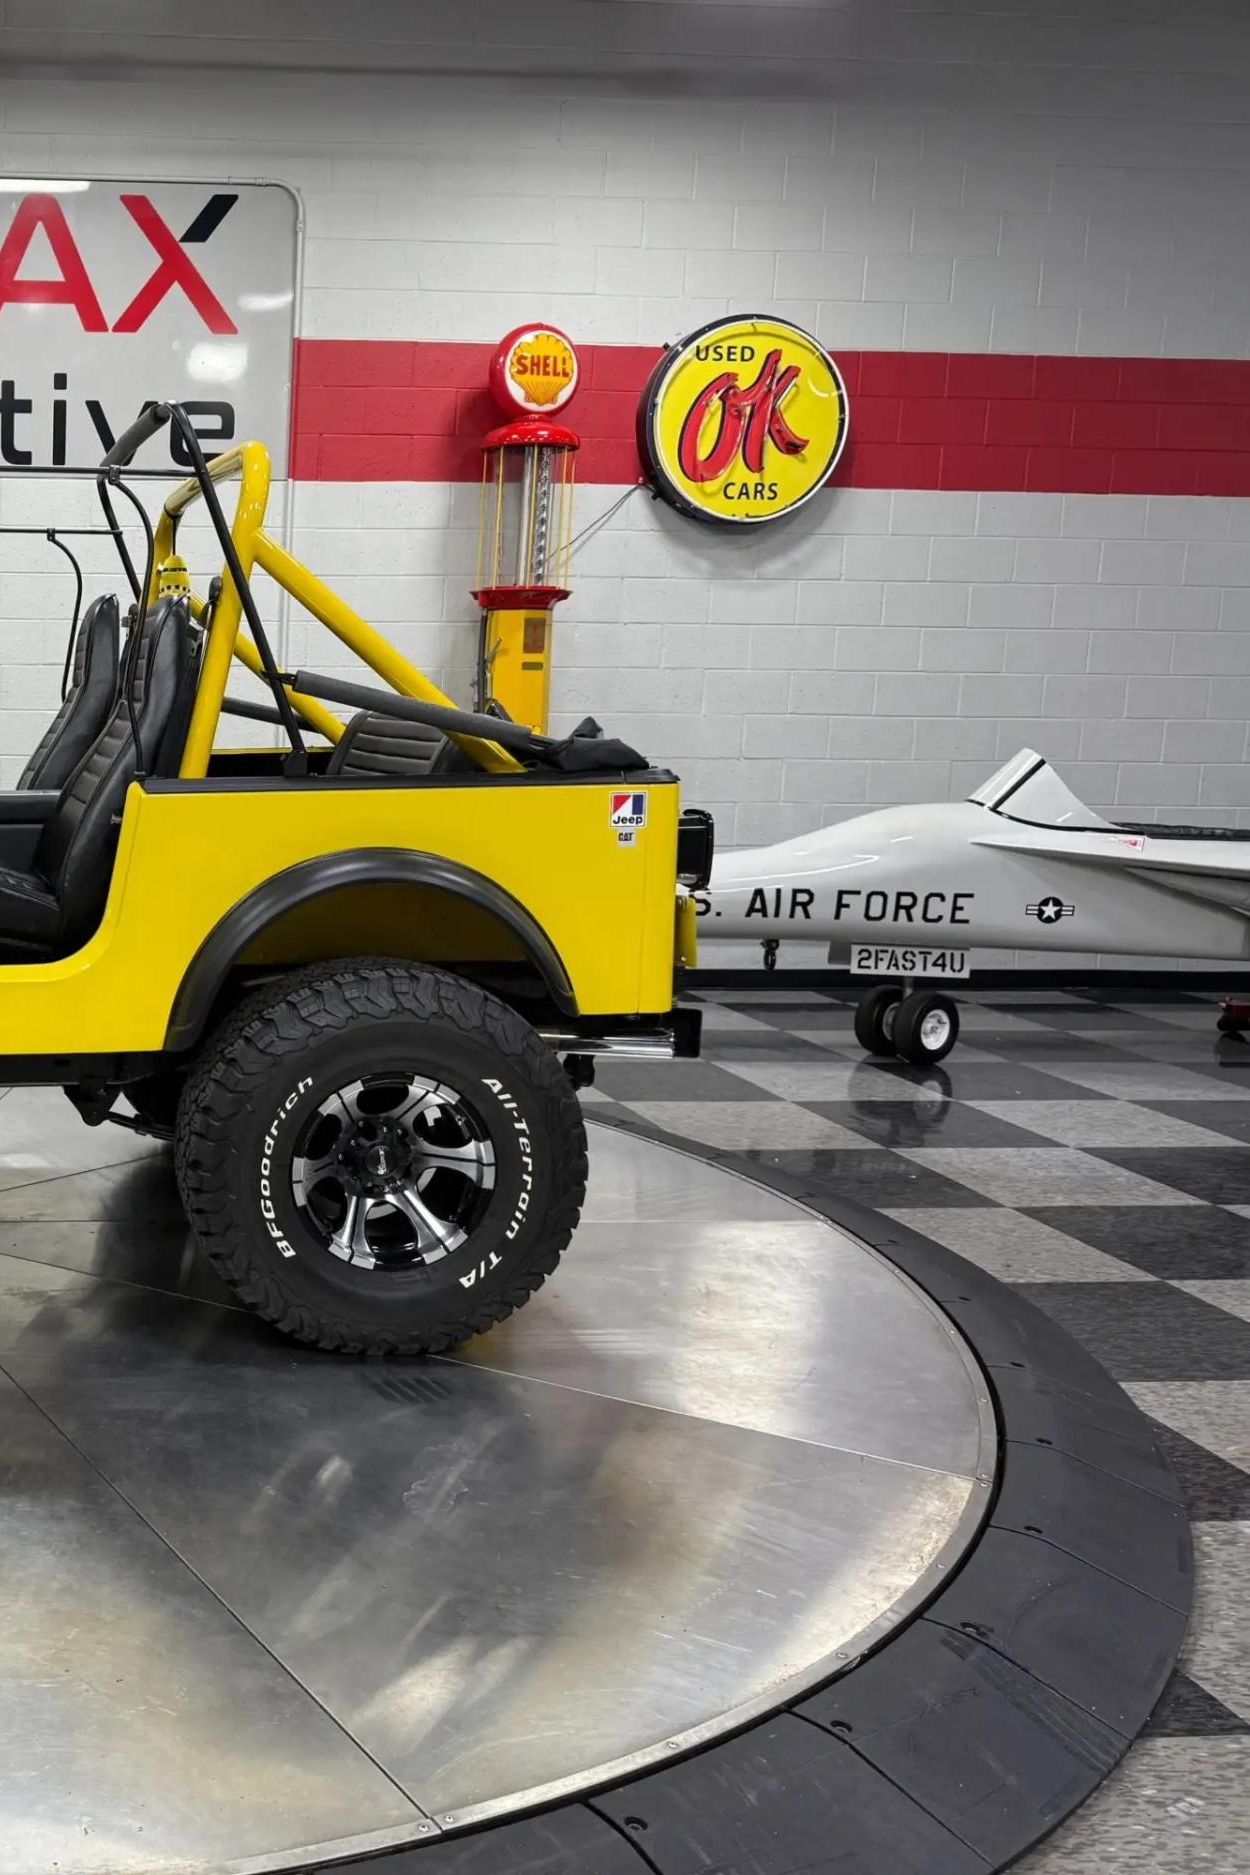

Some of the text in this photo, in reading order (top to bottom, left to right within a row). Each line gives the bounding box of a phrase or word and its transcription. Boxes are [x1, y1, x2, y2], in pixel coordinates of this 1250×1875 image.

[695, 344, 755, 362] USED
[516, 354, 570, 378] SHELL
[678, 349, 810, 483] OK
[723, 482, 778, 500] CARS
[612, 816, 643, 824] Jeep
[618, 832, 634, 841] CAT
[745, 888, 815, 919] AIR
[833, 890, 975, 924] FORCE
[856, 948, 966, 974] 2FAST4U
[260, 1076, 314, 1258] BFGoodrich
[458, 1078, 532, 1289] All-Terrain T/A
